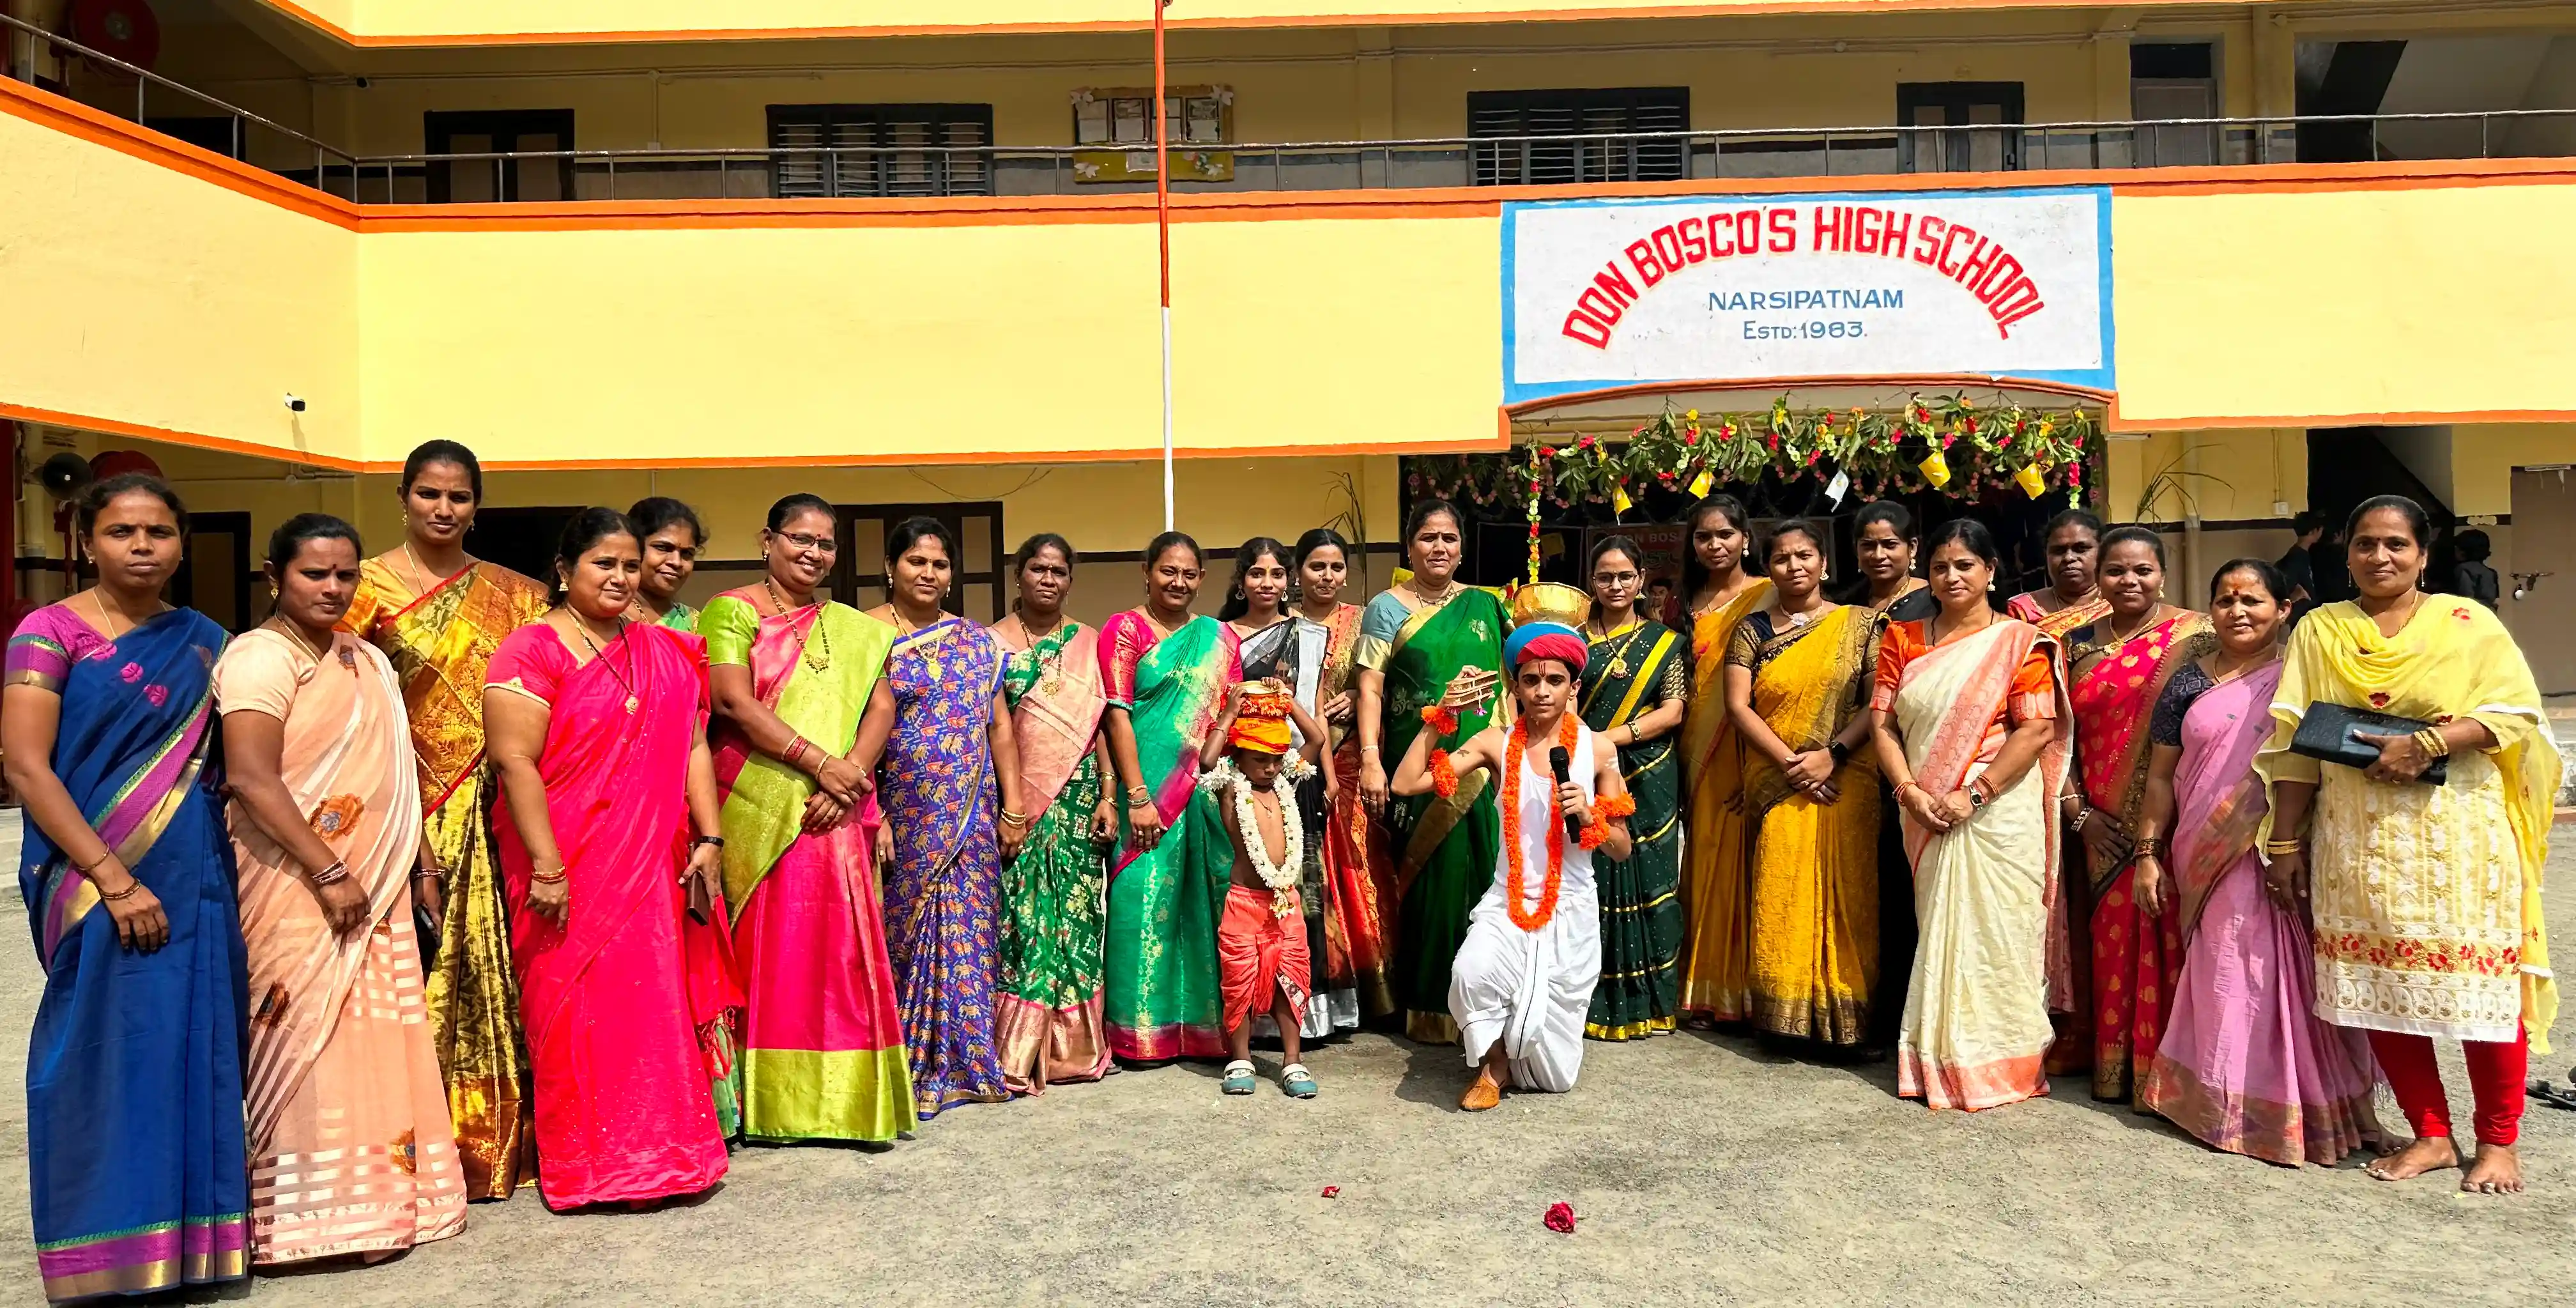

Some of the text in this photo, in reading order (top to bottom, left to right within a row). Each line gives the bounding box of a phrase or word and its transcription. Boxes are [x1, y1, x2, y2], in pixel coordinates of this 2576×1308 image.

[1562, 205, 2044, 348] DON BOSCO'S HIGH SCHOOL
[1708, 289, 1903, 310] NARSIPATNAM
